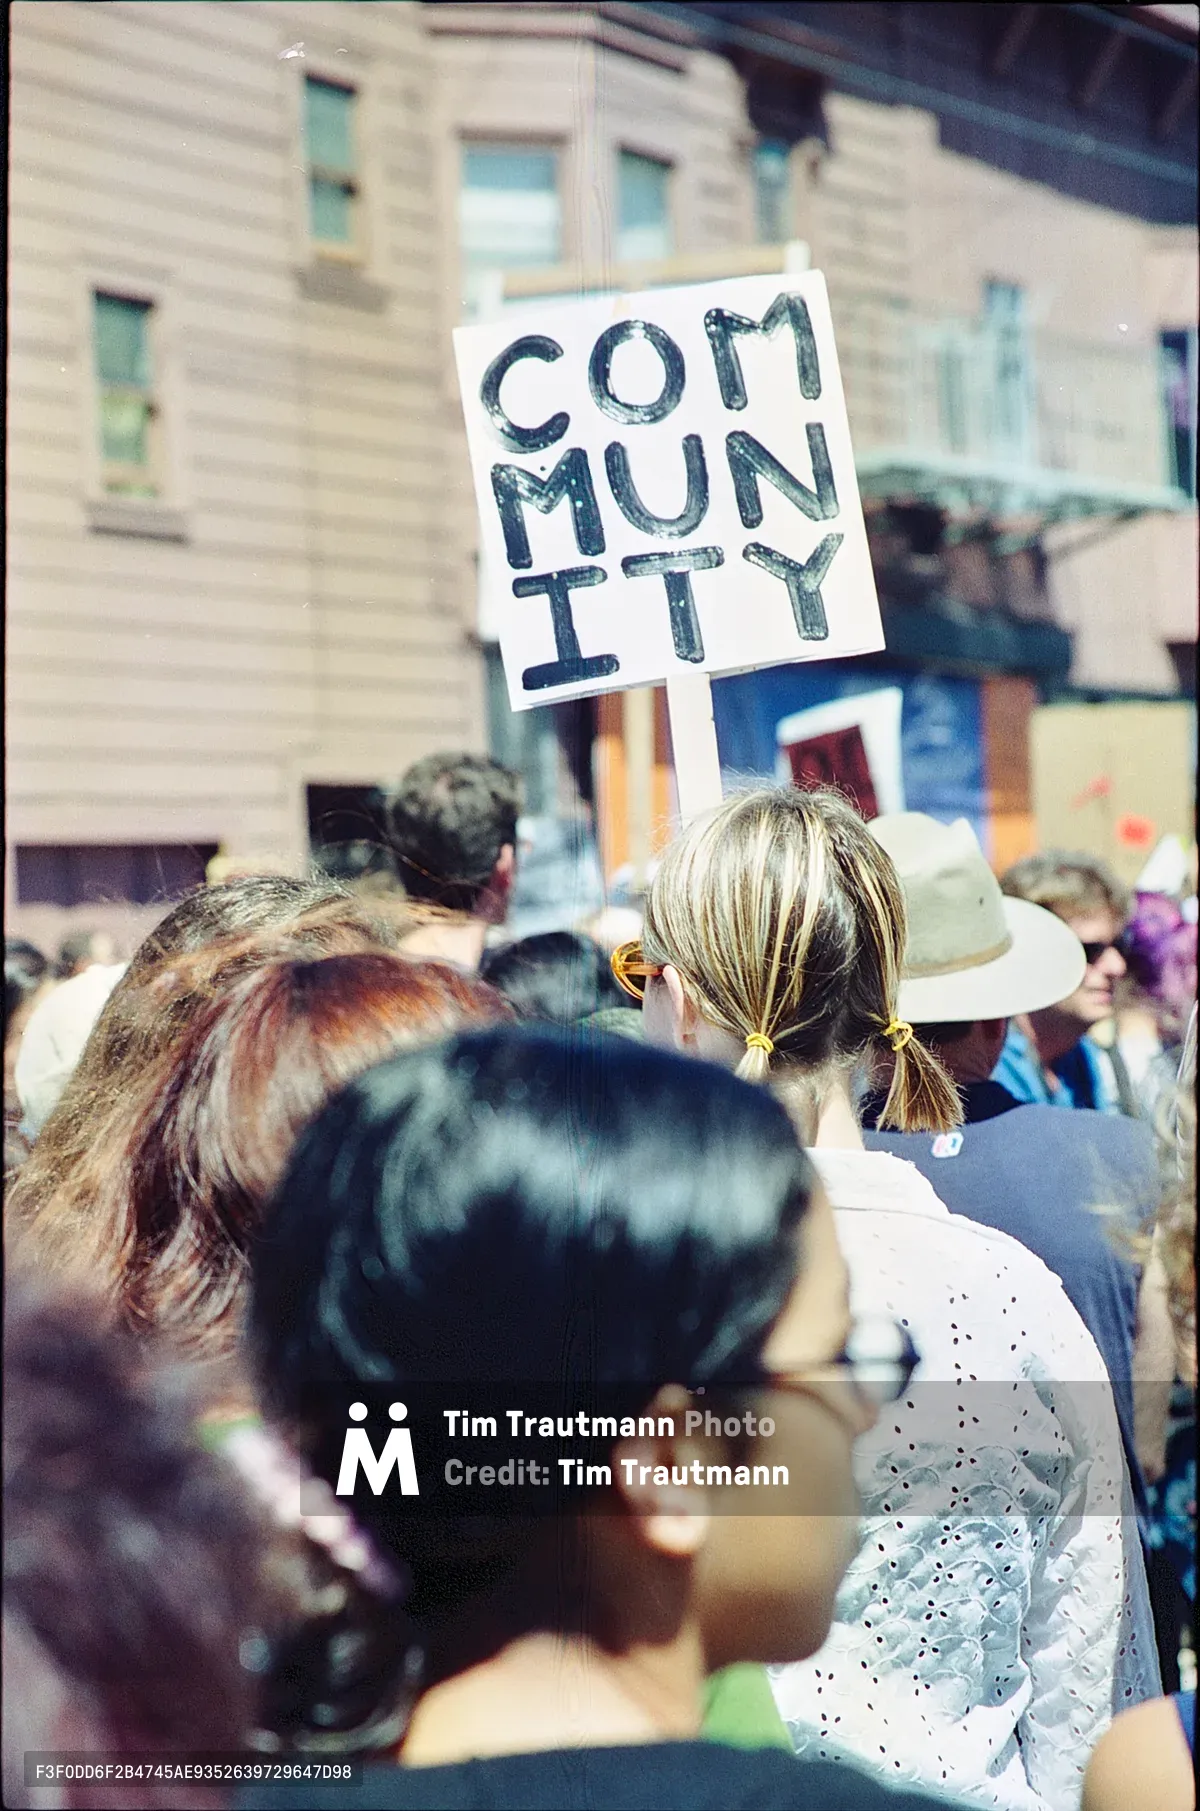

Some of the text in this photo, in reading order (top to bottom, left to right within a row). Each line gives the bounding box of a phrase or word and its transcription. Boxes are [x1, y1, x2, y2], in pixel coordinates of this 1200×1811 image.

[479, 292, 822, 454] COM
[490, 422, 840, 570] MUN
[511, 532, 845, 691] ITY
